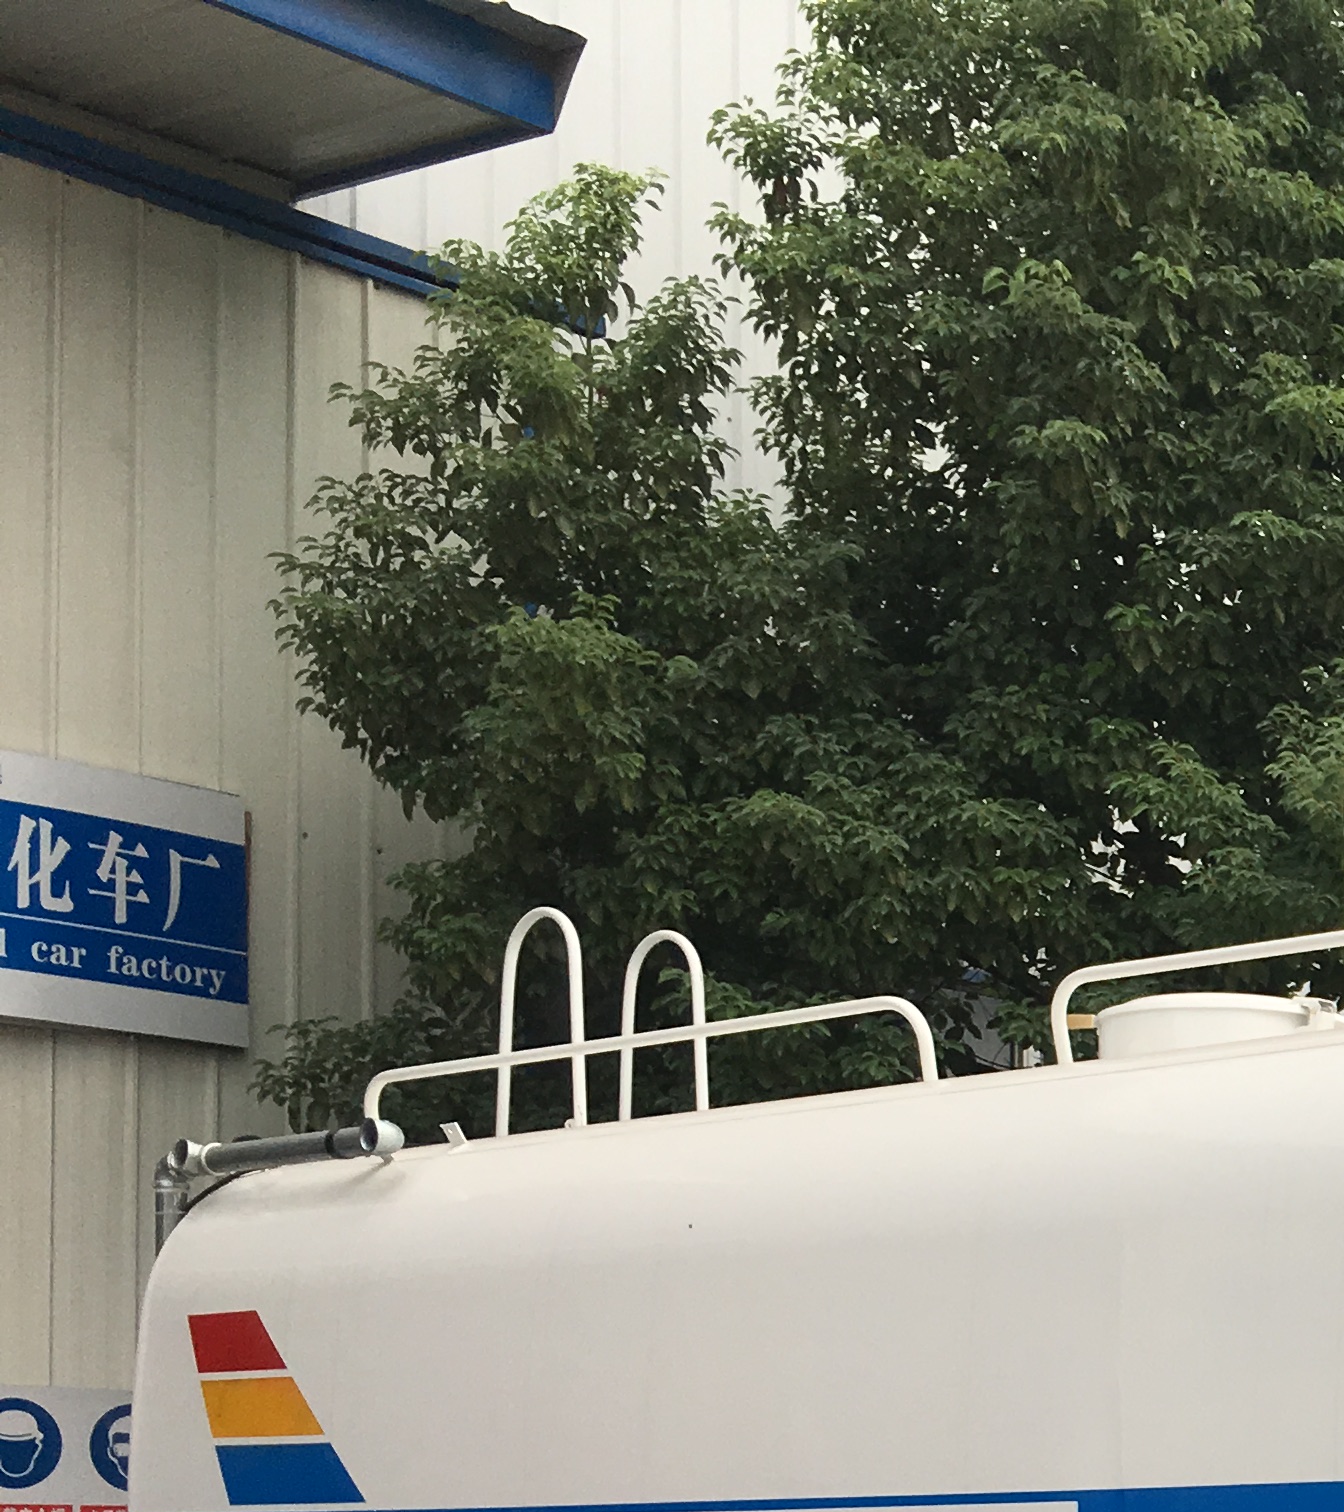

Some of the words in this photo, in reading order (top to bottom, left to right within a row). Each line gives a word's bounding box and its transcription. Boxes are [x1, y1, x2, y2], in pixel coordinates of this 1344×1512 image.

[7, 813, 221, 932] 化车厂
[31, 941, 87, 969] car
[107, 945, 227, 995] factory
